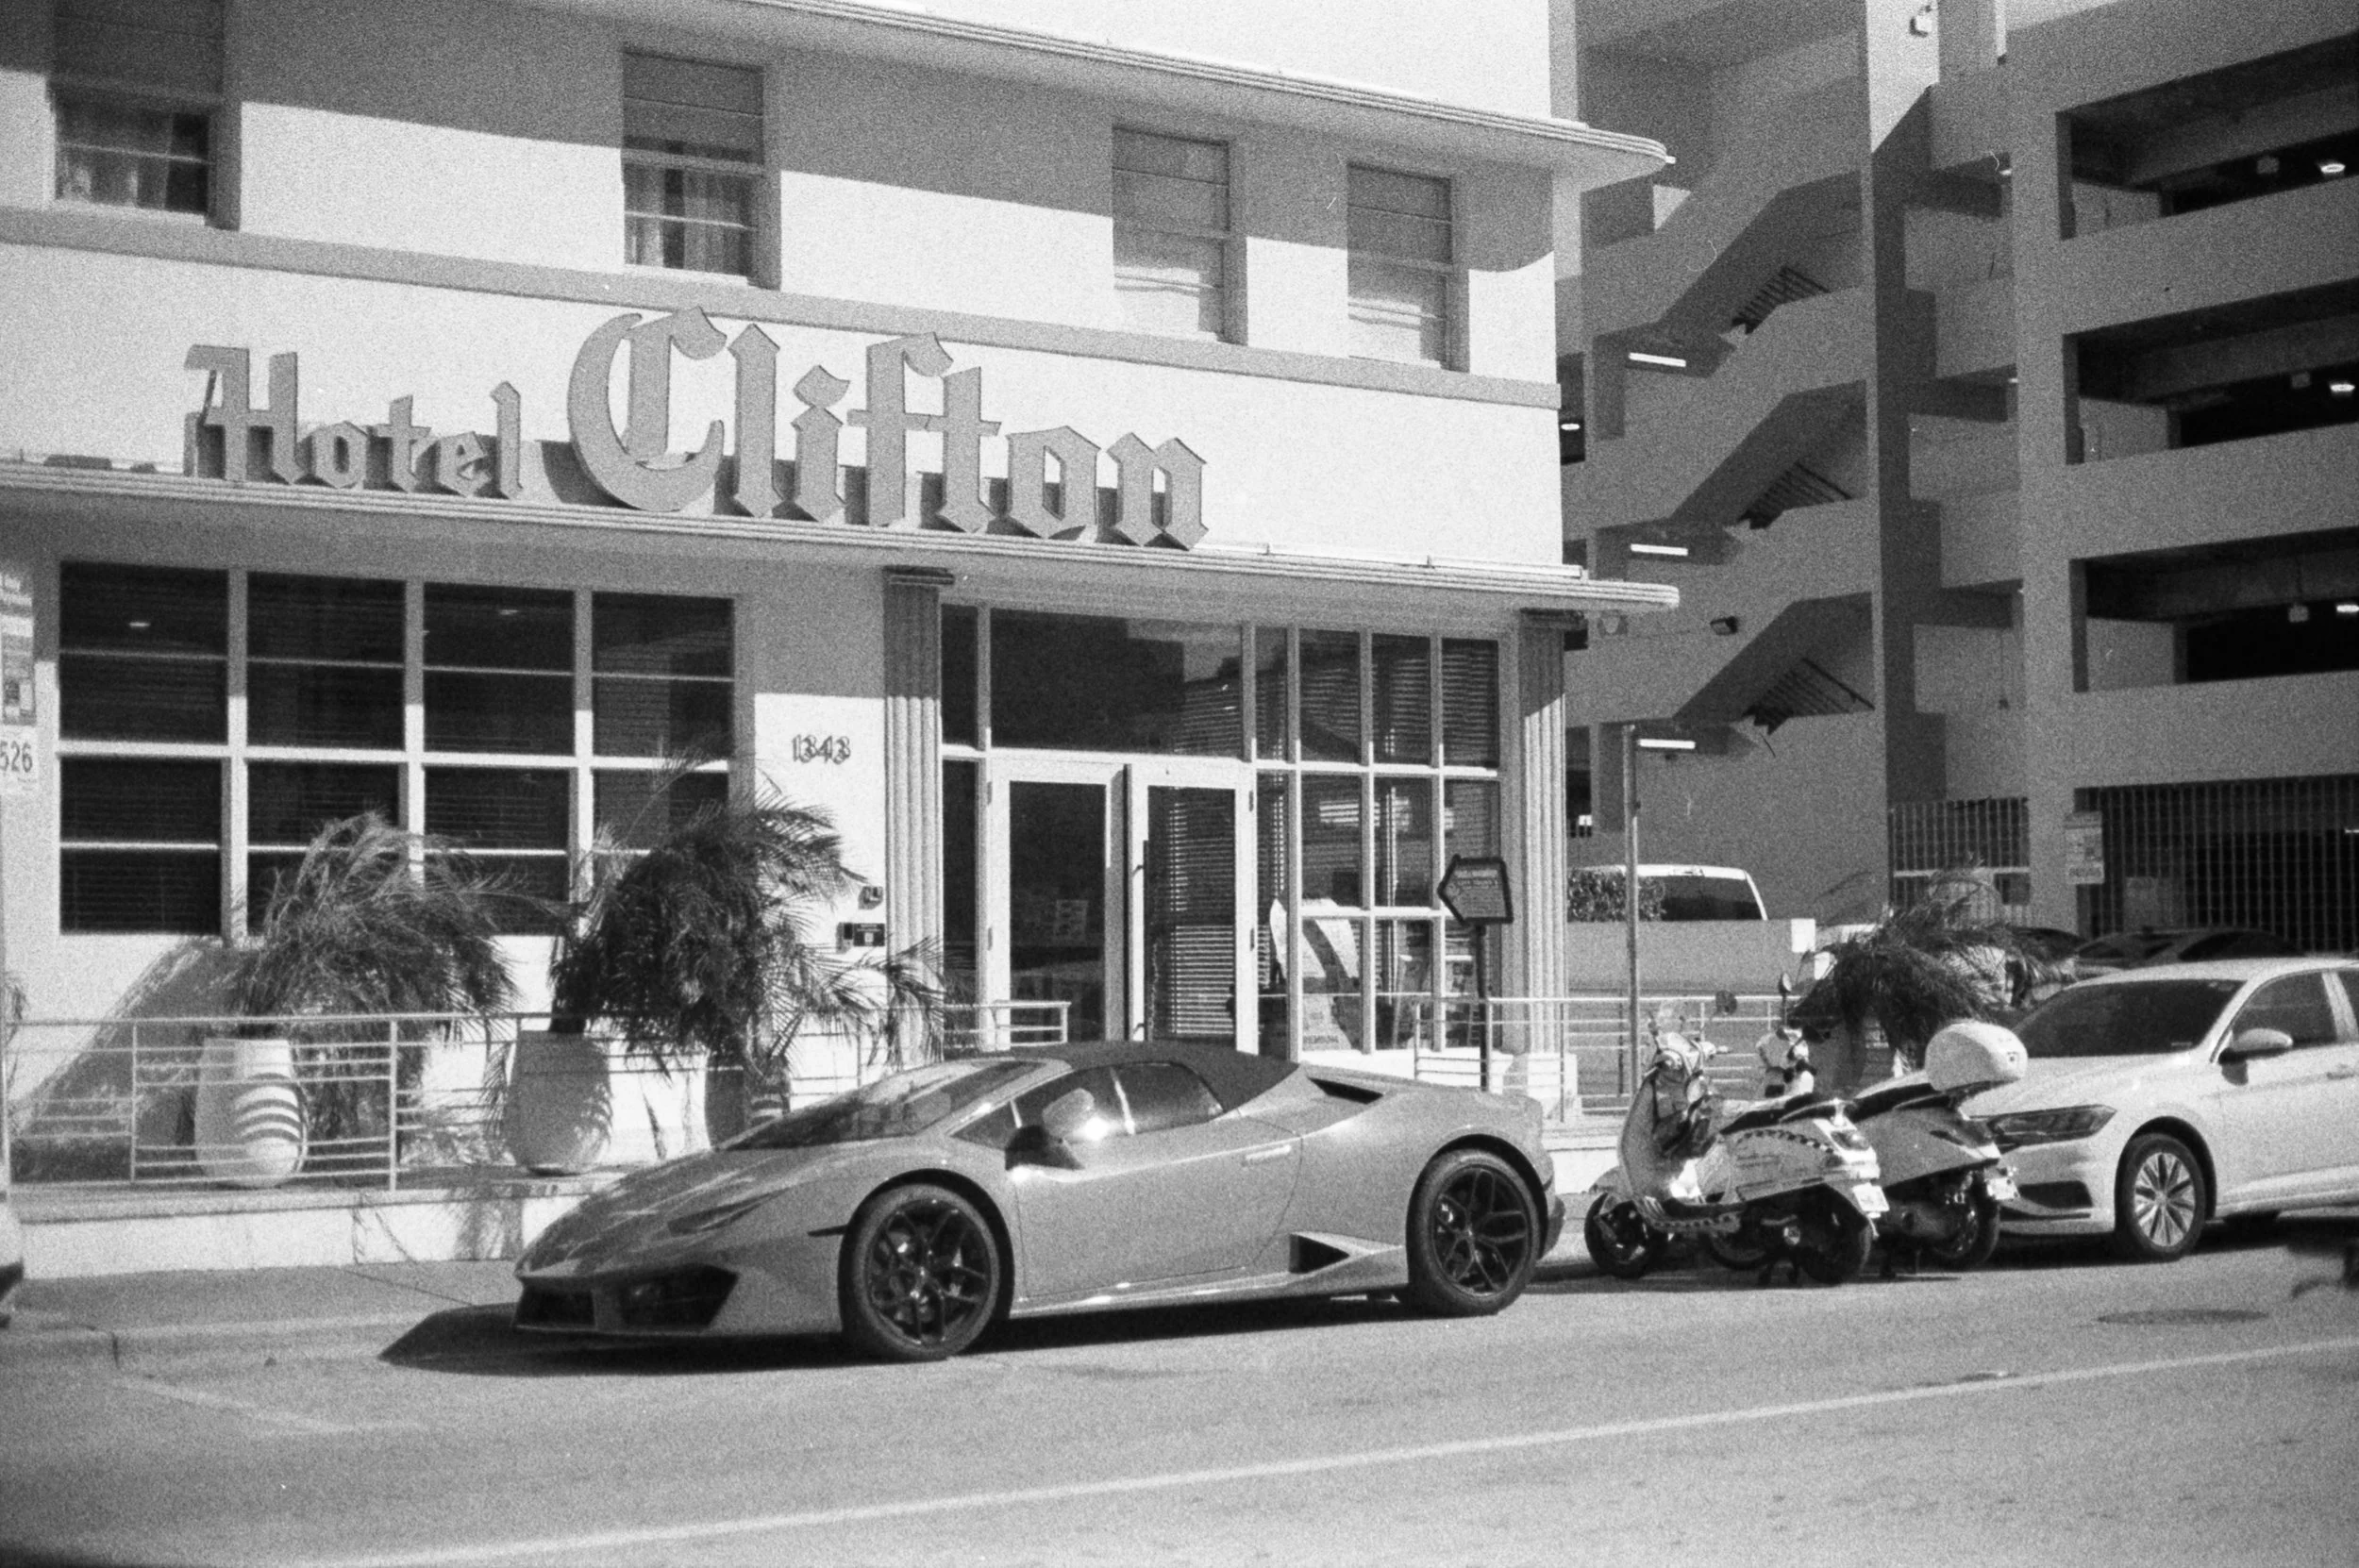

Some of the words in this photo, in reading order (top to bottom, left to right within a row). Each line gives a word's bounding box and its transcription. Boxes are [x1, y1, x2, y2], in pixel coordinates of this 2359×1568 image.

[184, 344, 523, 499] Hotel
[567, 306, 1209, 551] Clifton
[793, 734, 851, 765] 1343
